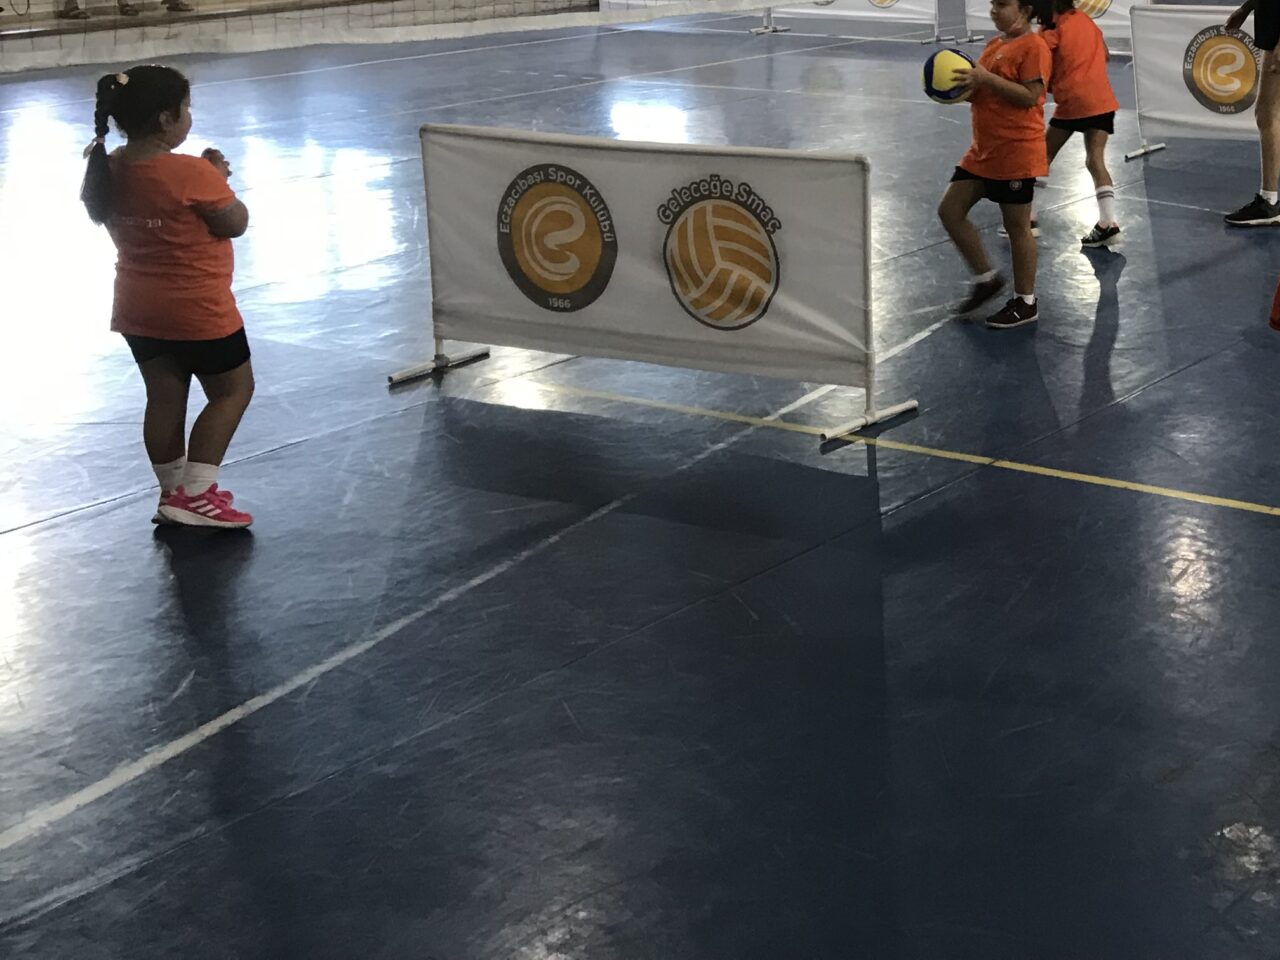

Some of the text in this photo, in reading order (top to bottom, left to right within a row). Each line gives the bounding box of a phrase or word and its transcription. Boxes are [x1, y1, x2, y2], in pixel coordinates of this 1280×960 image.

[500, 167, 615, 242] Eczacıbaşı Spor Kulübü
[658, 174, 781, 233] Geleceğe Smaç
[548, 297, 571, 309] 1966
